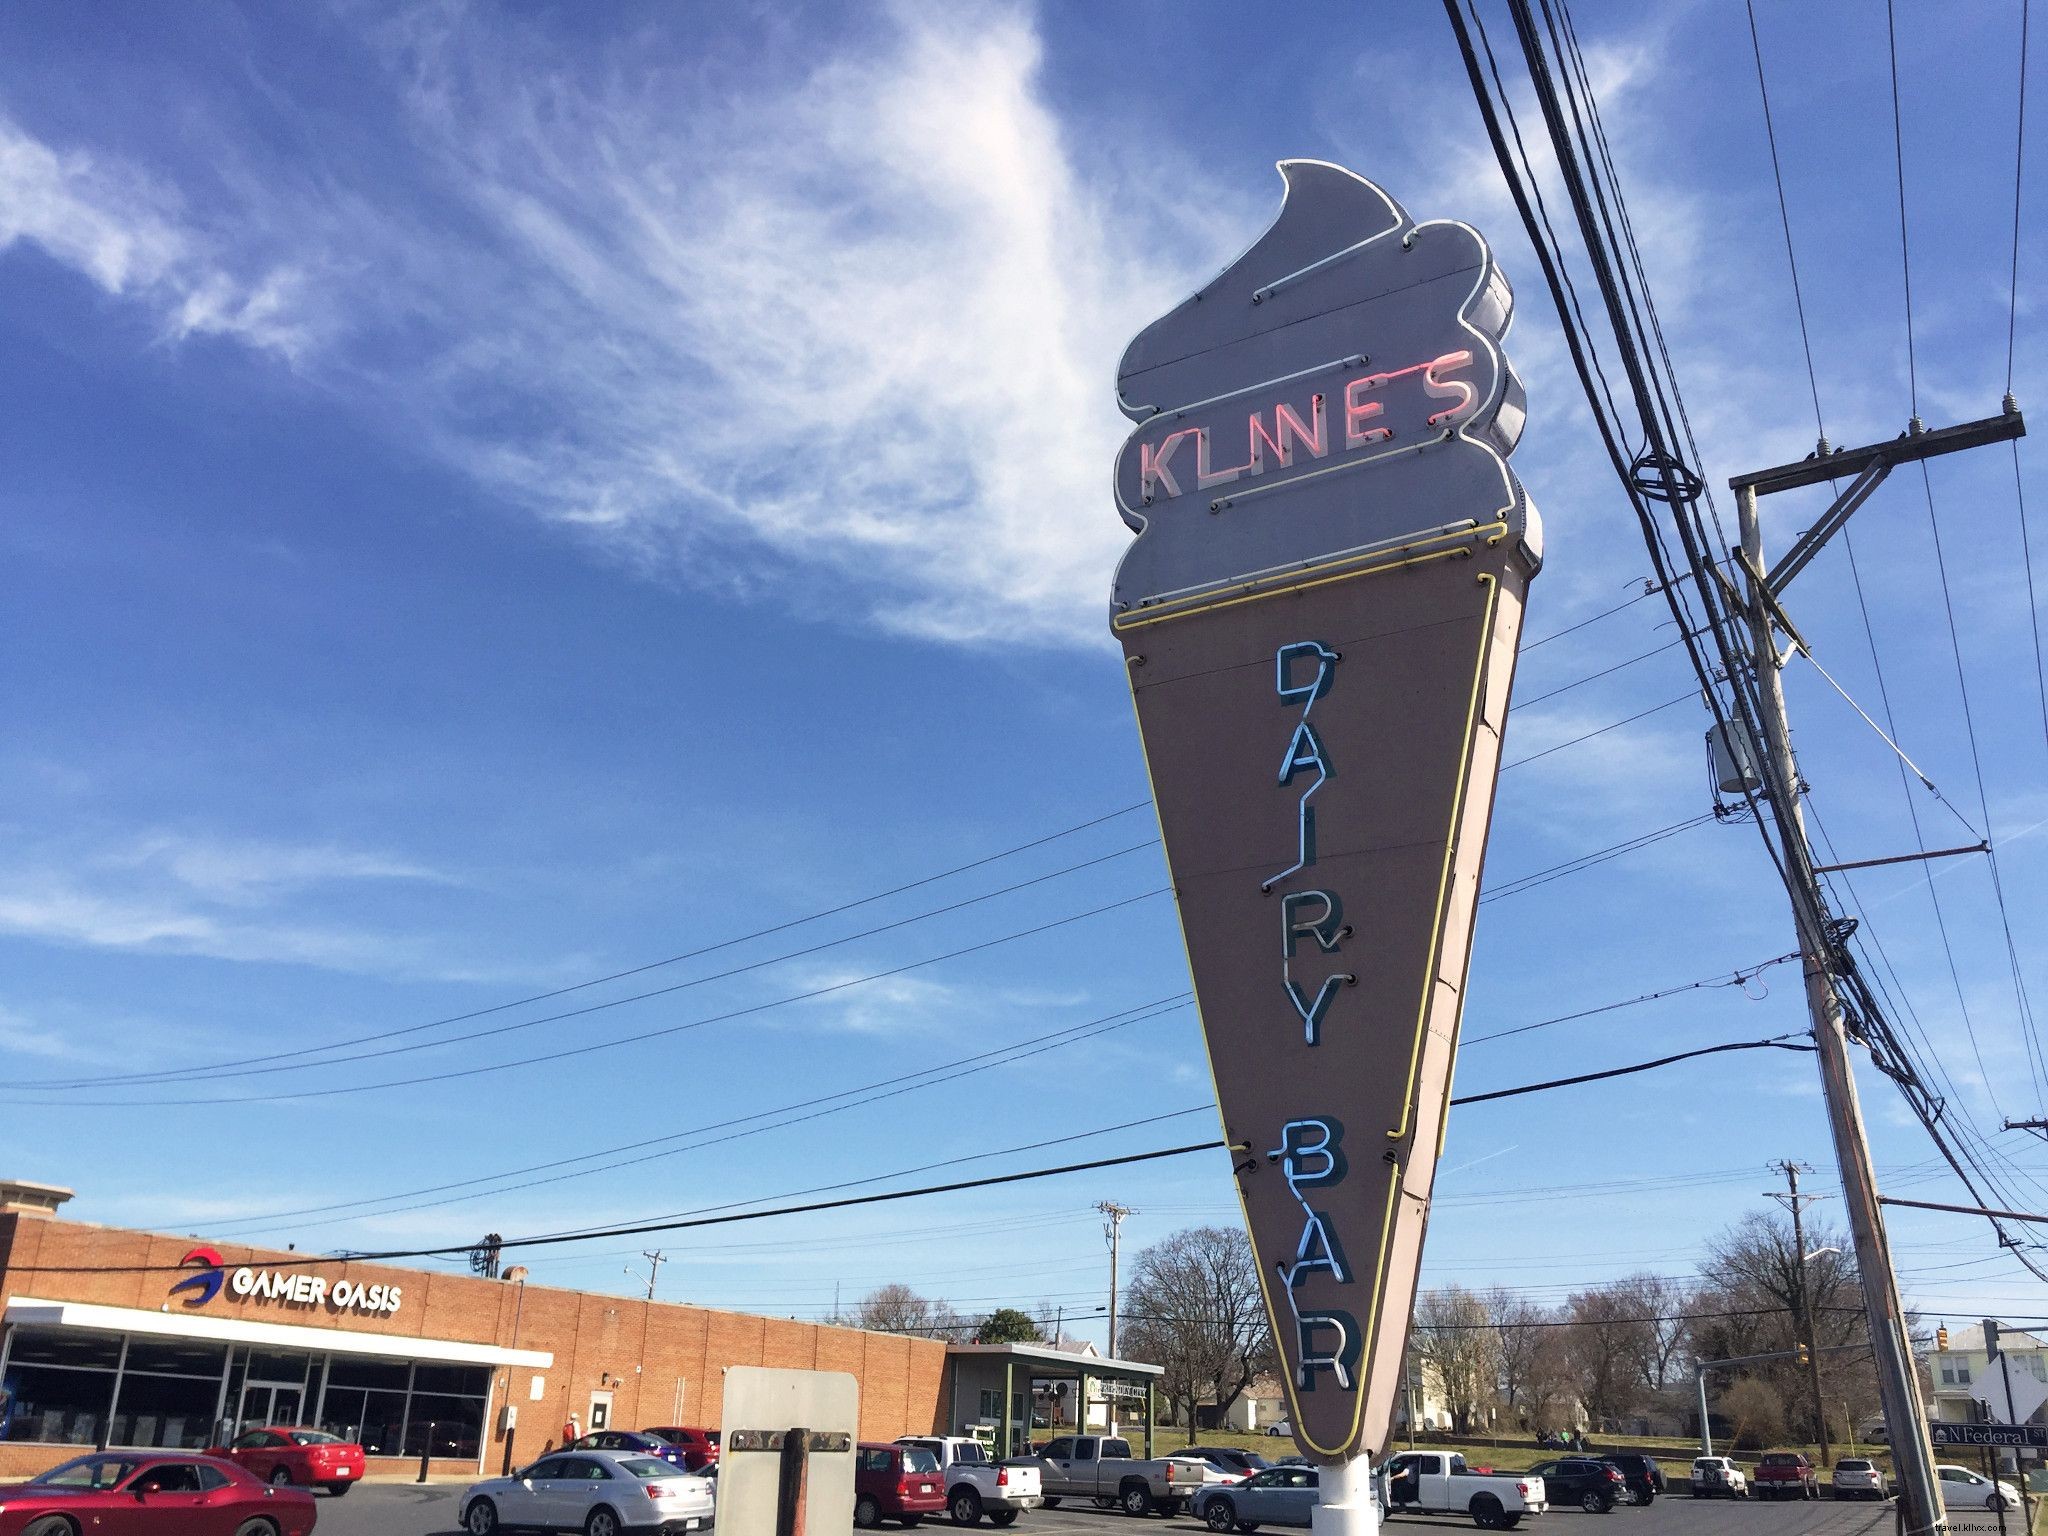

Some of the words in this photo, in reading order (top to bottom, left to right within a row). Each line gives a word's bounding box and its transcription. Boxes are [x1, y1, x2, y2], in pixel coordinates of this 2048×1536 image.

[1276, 640, 1344, 1048] DAIRY
[232, 1267, 327, 1304] GAMER
[332, 1280, 402, 1312] OASIS
[1284, 1114, 1362, 1392] BAR
[1949, 1427, 1960, 1441] N
[1963, 1427, 2031, 1445] Federal
[2033, 1429, 2045, 1438] ST
